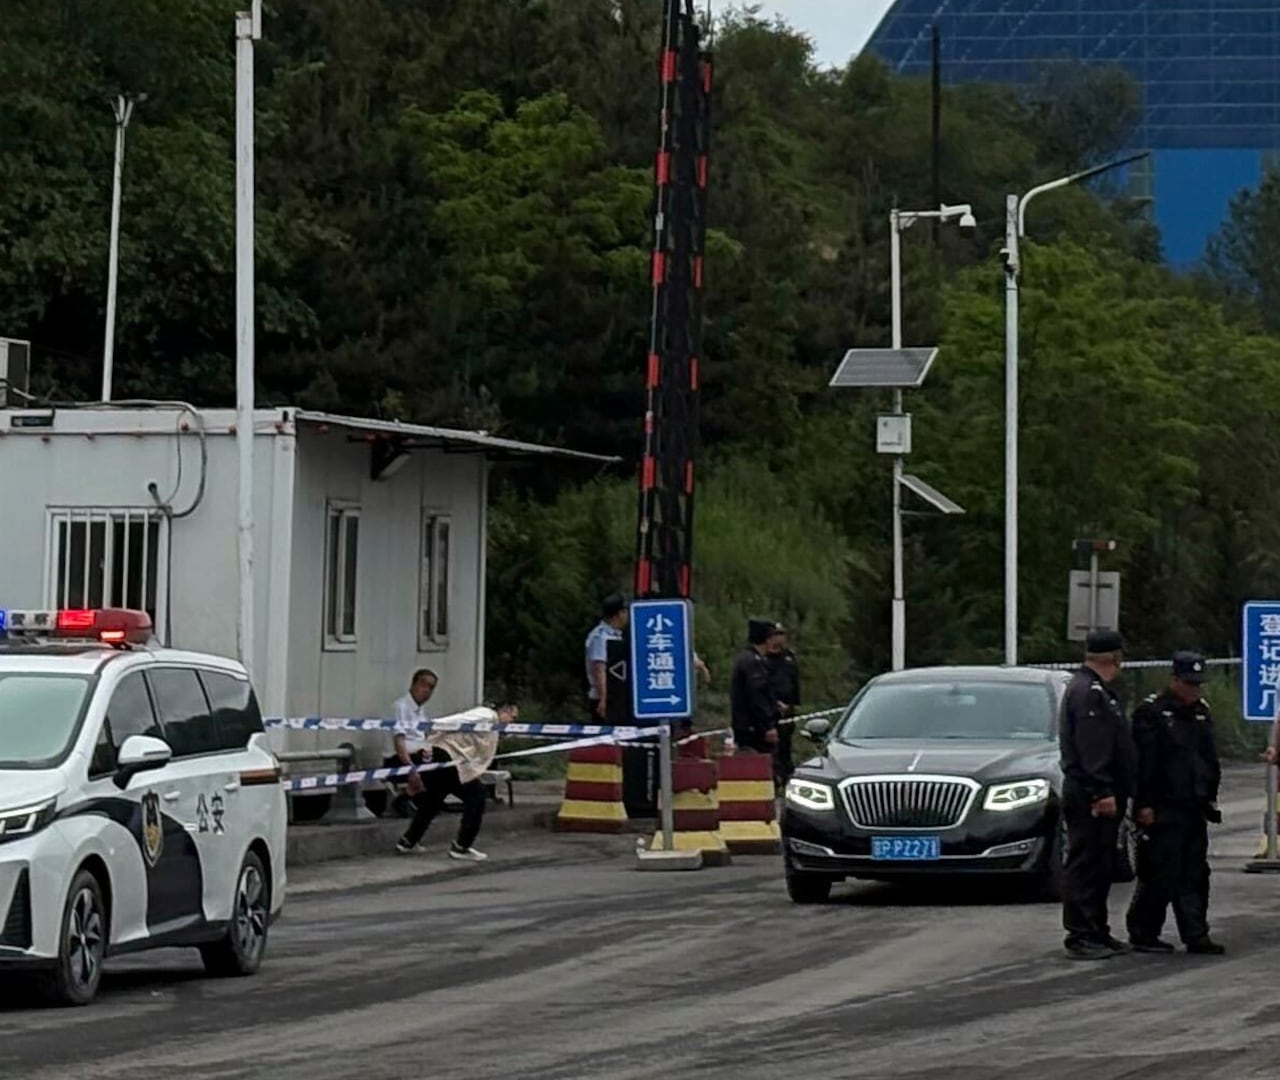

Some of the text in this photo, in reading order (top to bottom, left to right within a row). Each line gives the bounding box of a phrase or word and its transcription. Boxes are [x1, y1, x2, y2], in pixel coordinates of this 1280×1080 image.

[646, 613, 675, 690] 小车通道
[196, 791, 225, 835] 公安
